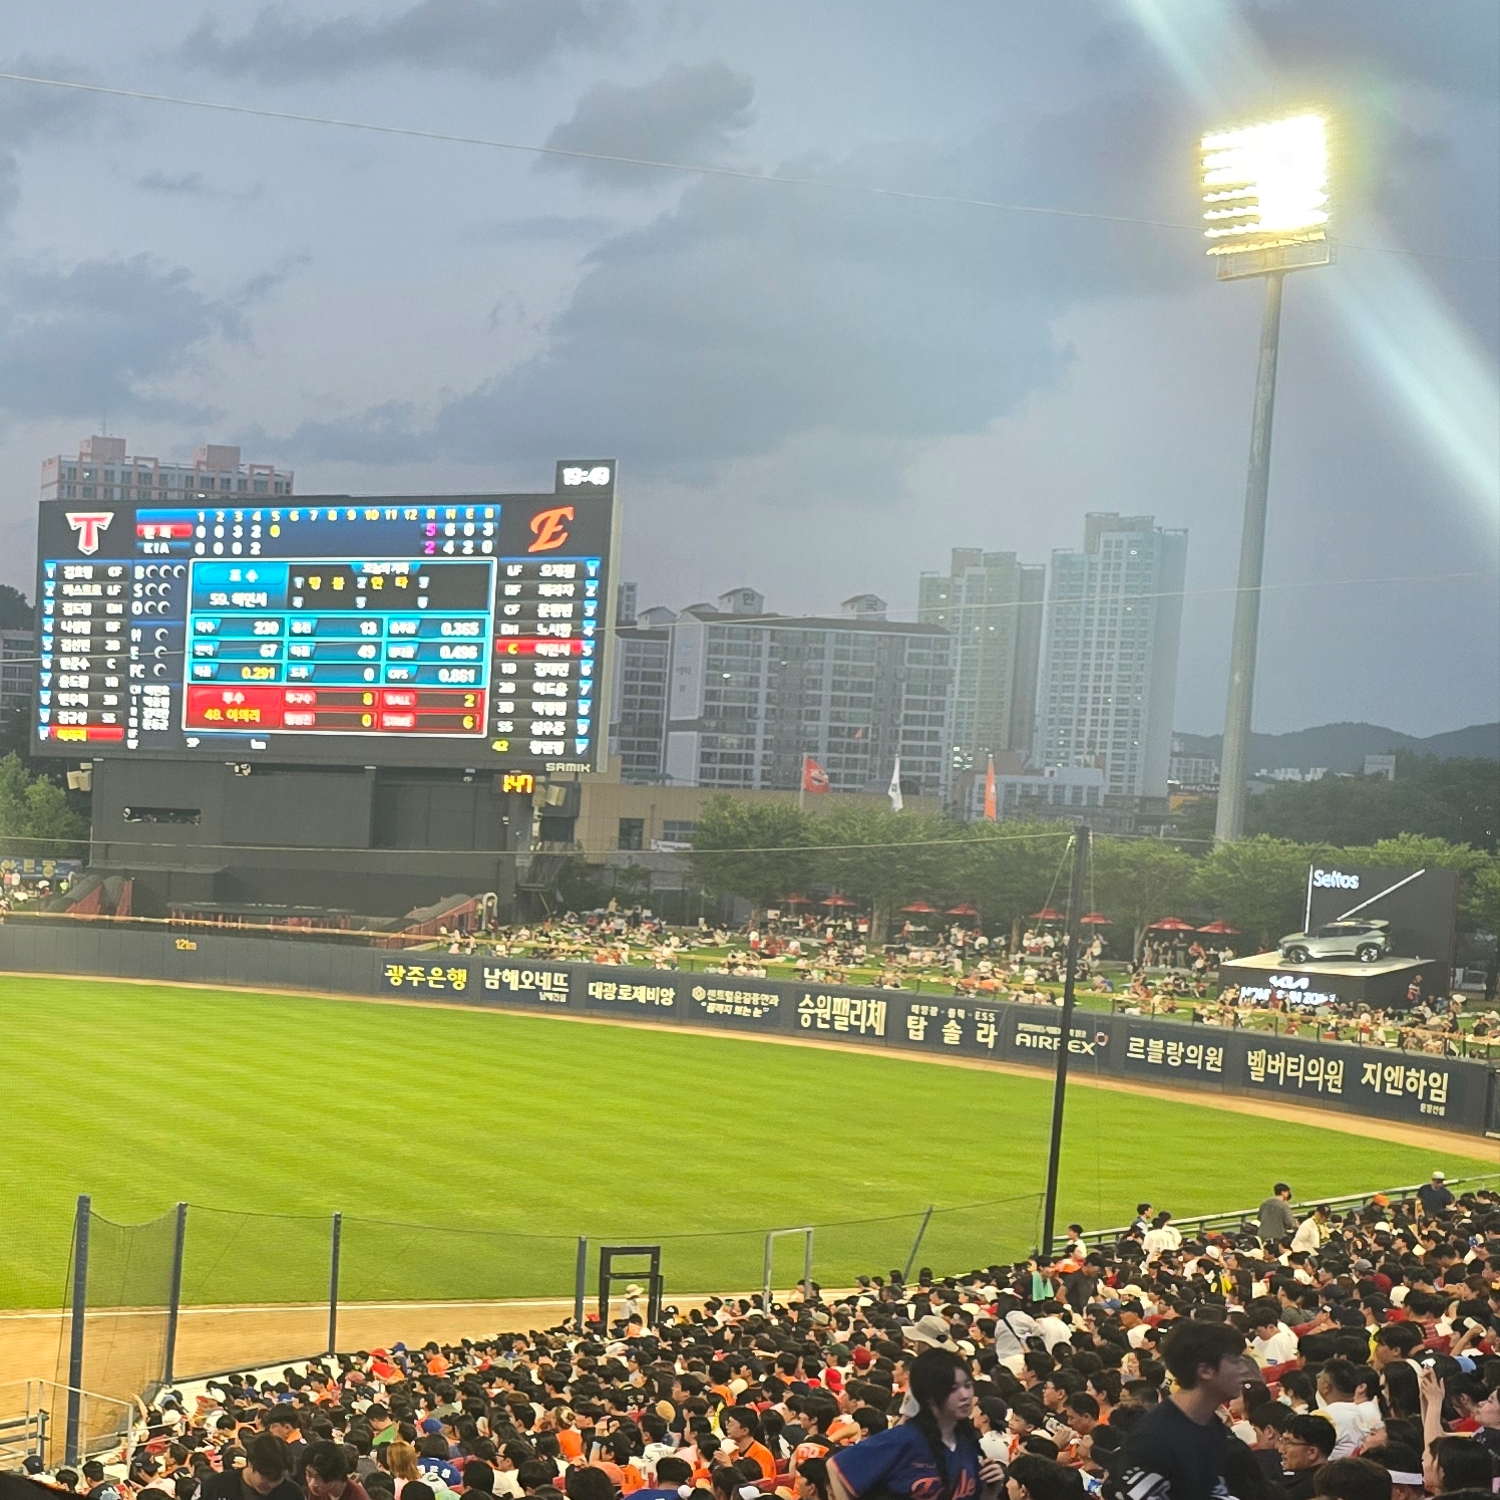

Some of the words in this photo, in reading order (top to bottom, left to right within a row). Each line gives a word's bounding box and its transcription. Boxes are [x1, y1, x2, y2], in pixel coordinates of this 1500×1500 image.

[198, 511, 205, 522] 1
[216, 511, 224, 522] 2
[234, 511, 243, 522] 3
[252, 510, 261, 522] 4
[271, 510, 280, 522] 5
[289, 510, 299, 521] 6
[309, 510, 318, 521] 7
[364, 509, 379, 520] 10
[384, 509, 397, 520] 11
[404, 508, 418, 520] 12
[196, 525, 206, 538] 0
[214, 525, 224, 538] 0
[232, 525, 243, 538] 3
[251, 525, 261, 538] 2
[483, 523, 493, 537] 3
[143, 542, 170, 554] KIA
[195, 542, 205, 555] 0
[213, 542, 224, 555] 0
[232, 542, 242, 555] 0
[250, 542, 261, 555] 2
[425, 541, 436, 554] 2
[443, 540, 454, 554] 4
[463, 540, 474, 554] 2
[241, 667, 275, 680] 0.291
[464, 694, 474, 707] 2
[545, 763, 590, 773] SAMIK
[1313, 869, 1359, 889] Seltos
[384, 963, 467, 991] 광주은행
[483, 968, 570, 993] 남해오네뜨
[588, 981, 676, 1006] 대광로제비앙
[797, 994, 887, 1036] 승원팰리체
[974, 1010, 995, 1023] ESS
[1126, 1037, 1223, 1072] 르블랑의원
[1361, 1062, 1448, 1103] 지엔하임
